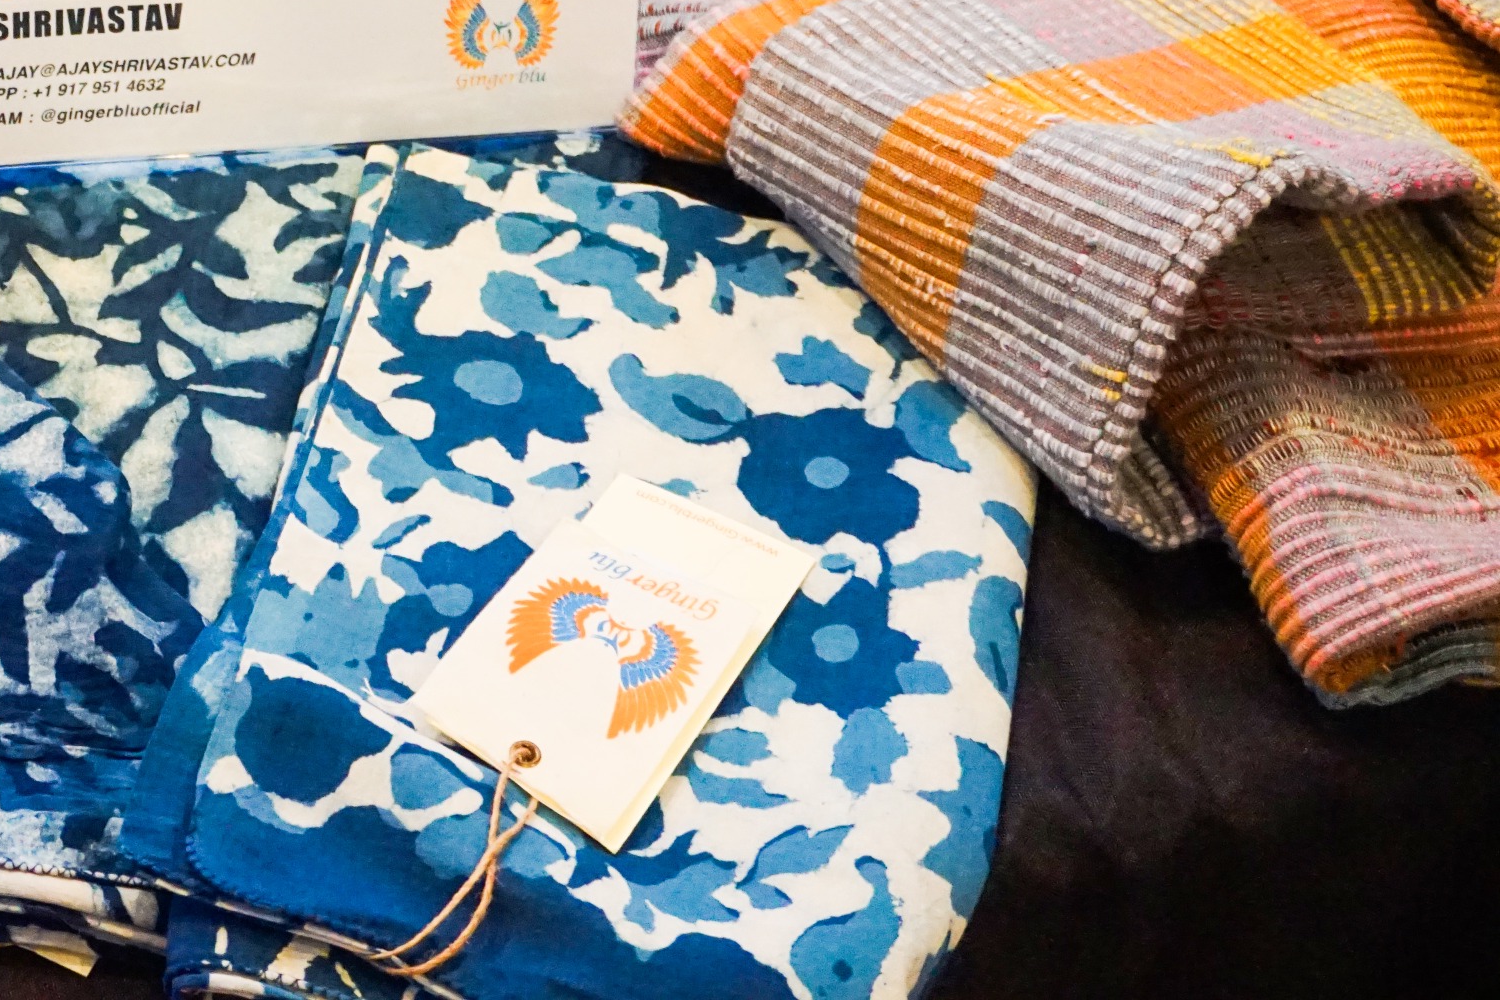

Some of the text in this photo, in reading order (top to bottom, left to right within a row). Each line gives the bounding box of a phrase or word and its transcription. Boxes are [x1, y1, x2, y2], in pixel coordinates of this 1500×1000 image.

[32, 84, 52, 98] +1
[57, 81, 88, 97] 917
[92, 80, 120, 95] 951
[125, 77, 166, 92] 4632
[40, 100, 201, 125] @gingerbluofficial
[588, 550, 720, 622] Gingerblu
